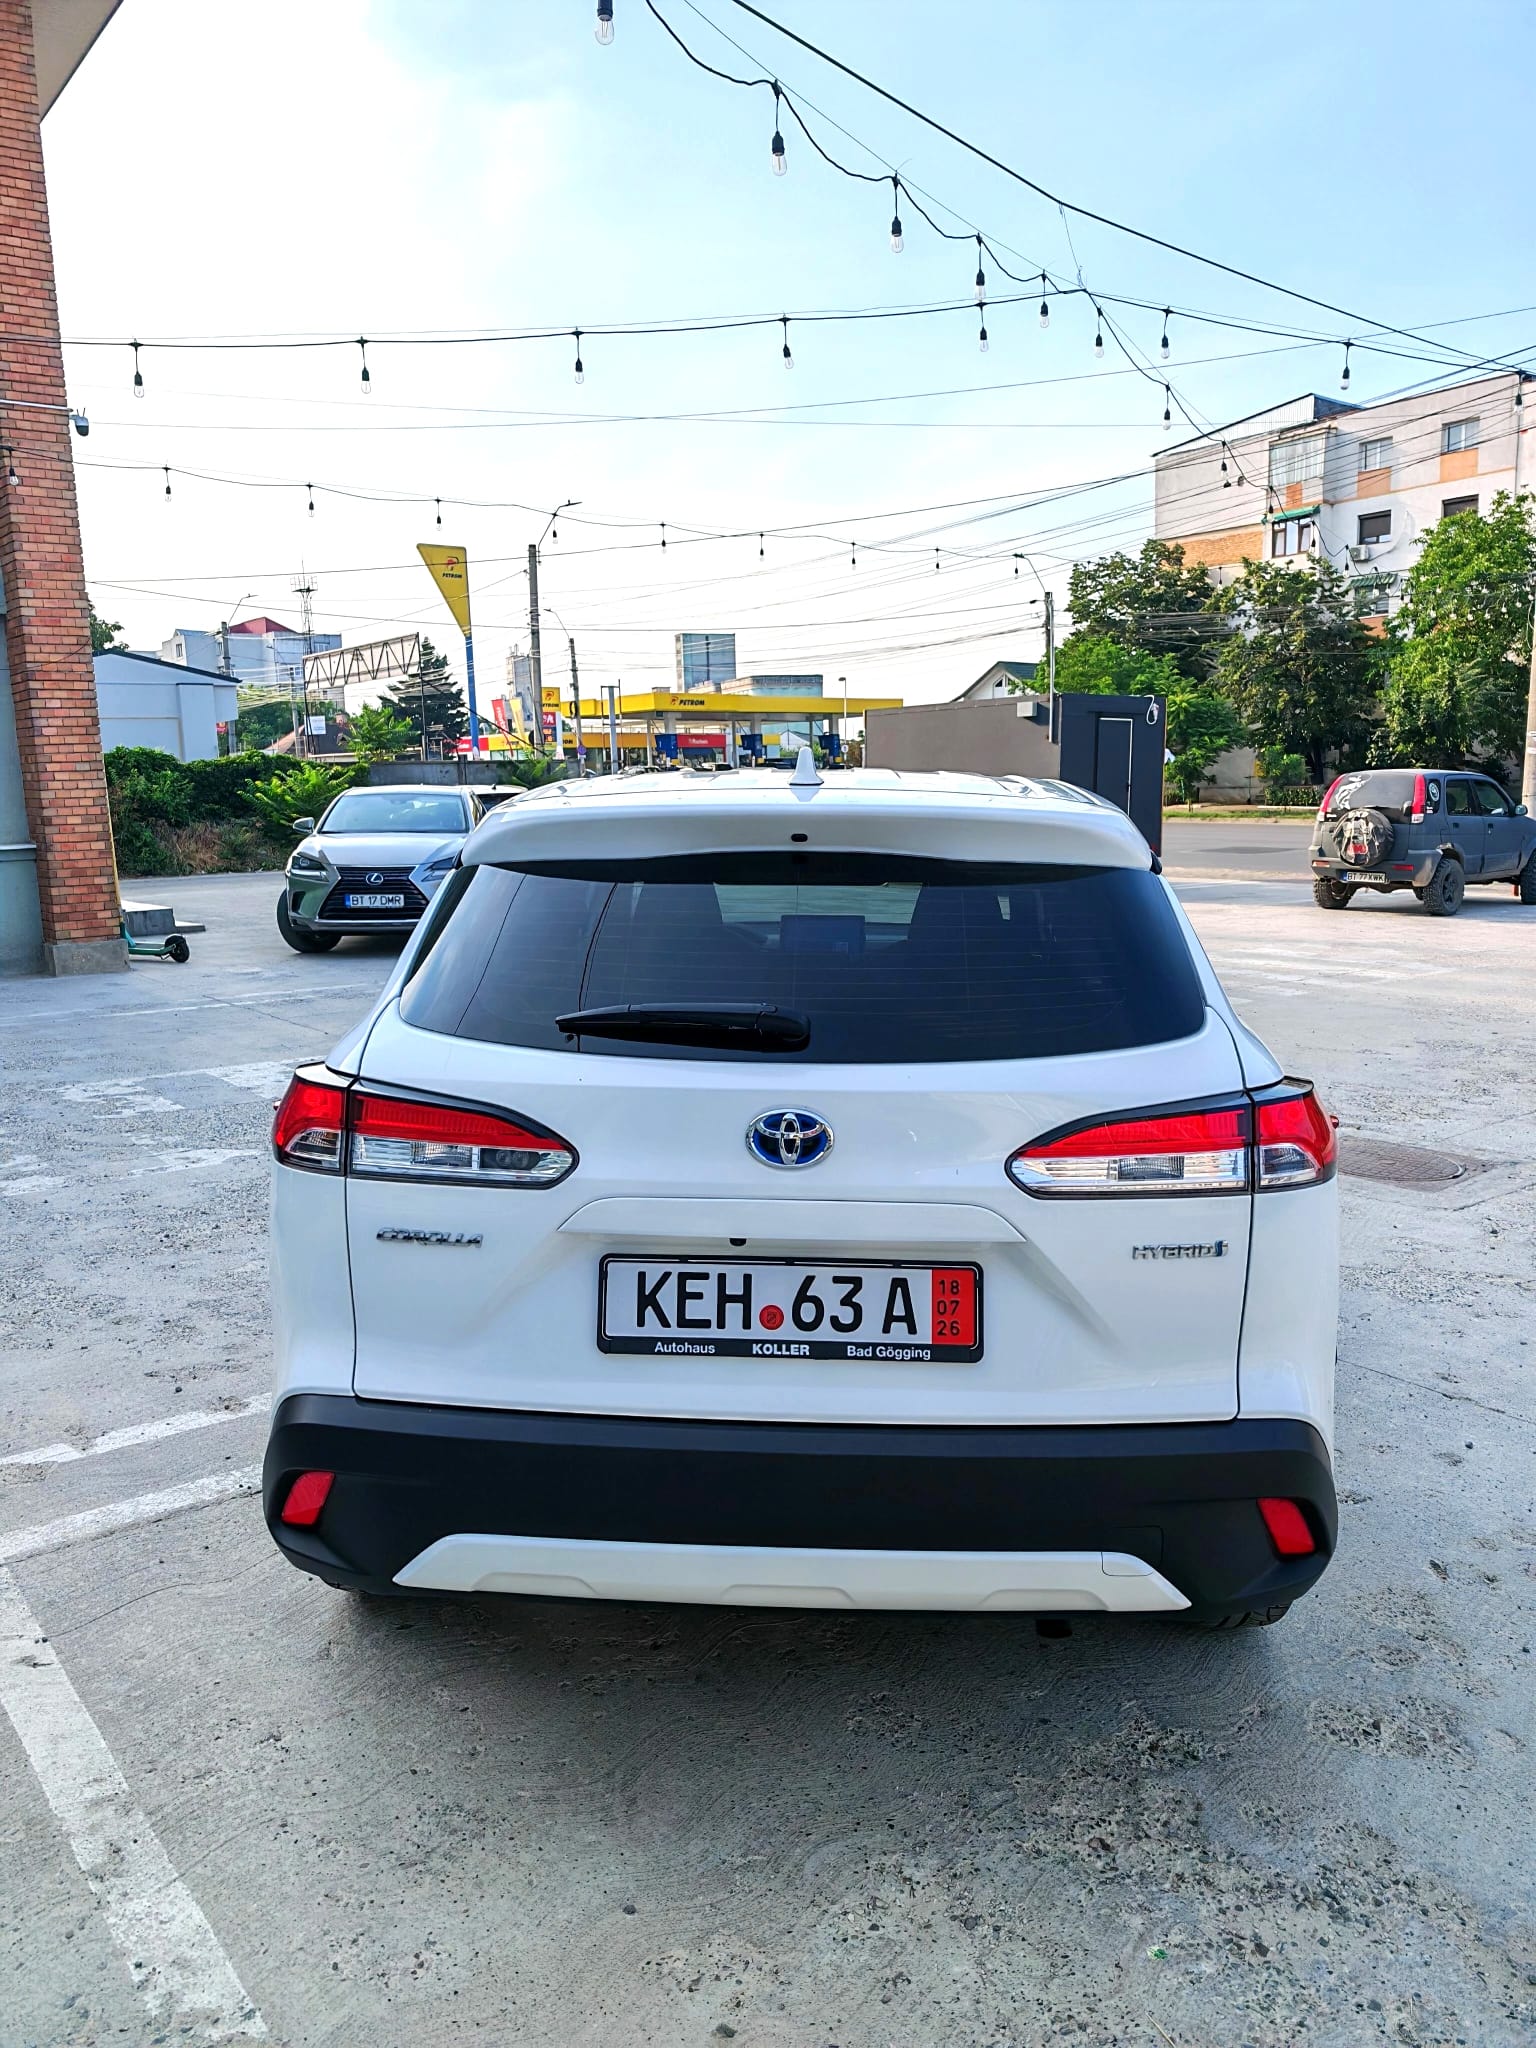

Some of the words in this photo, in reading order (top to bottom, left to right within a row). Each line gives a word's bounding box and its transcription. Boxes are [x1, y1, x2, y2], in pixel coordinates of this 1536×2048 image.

[678, 698, 705, 706] PETROM
[351, 895, 364, 906] BT
[368, 895, 378, 906] 17
[380, 895, 401, 906] DMR
[937, 1278, 961, 1296] 18
[636, 1270, 753, 1330] KEH
[791, 1274, 864, 1334] 63
[881, 1276, 918, 1336] A
[936, 1299, 961, 1316] 07
[936, 1320, 961, 1337] 26
[654, 1340, 716, 1355] Autohaus
[751, 1343, 810, 1356] KOLLER
[847, 1345, 873, 1358] Bad
[875, 1345, 932, 1362] Gögging
